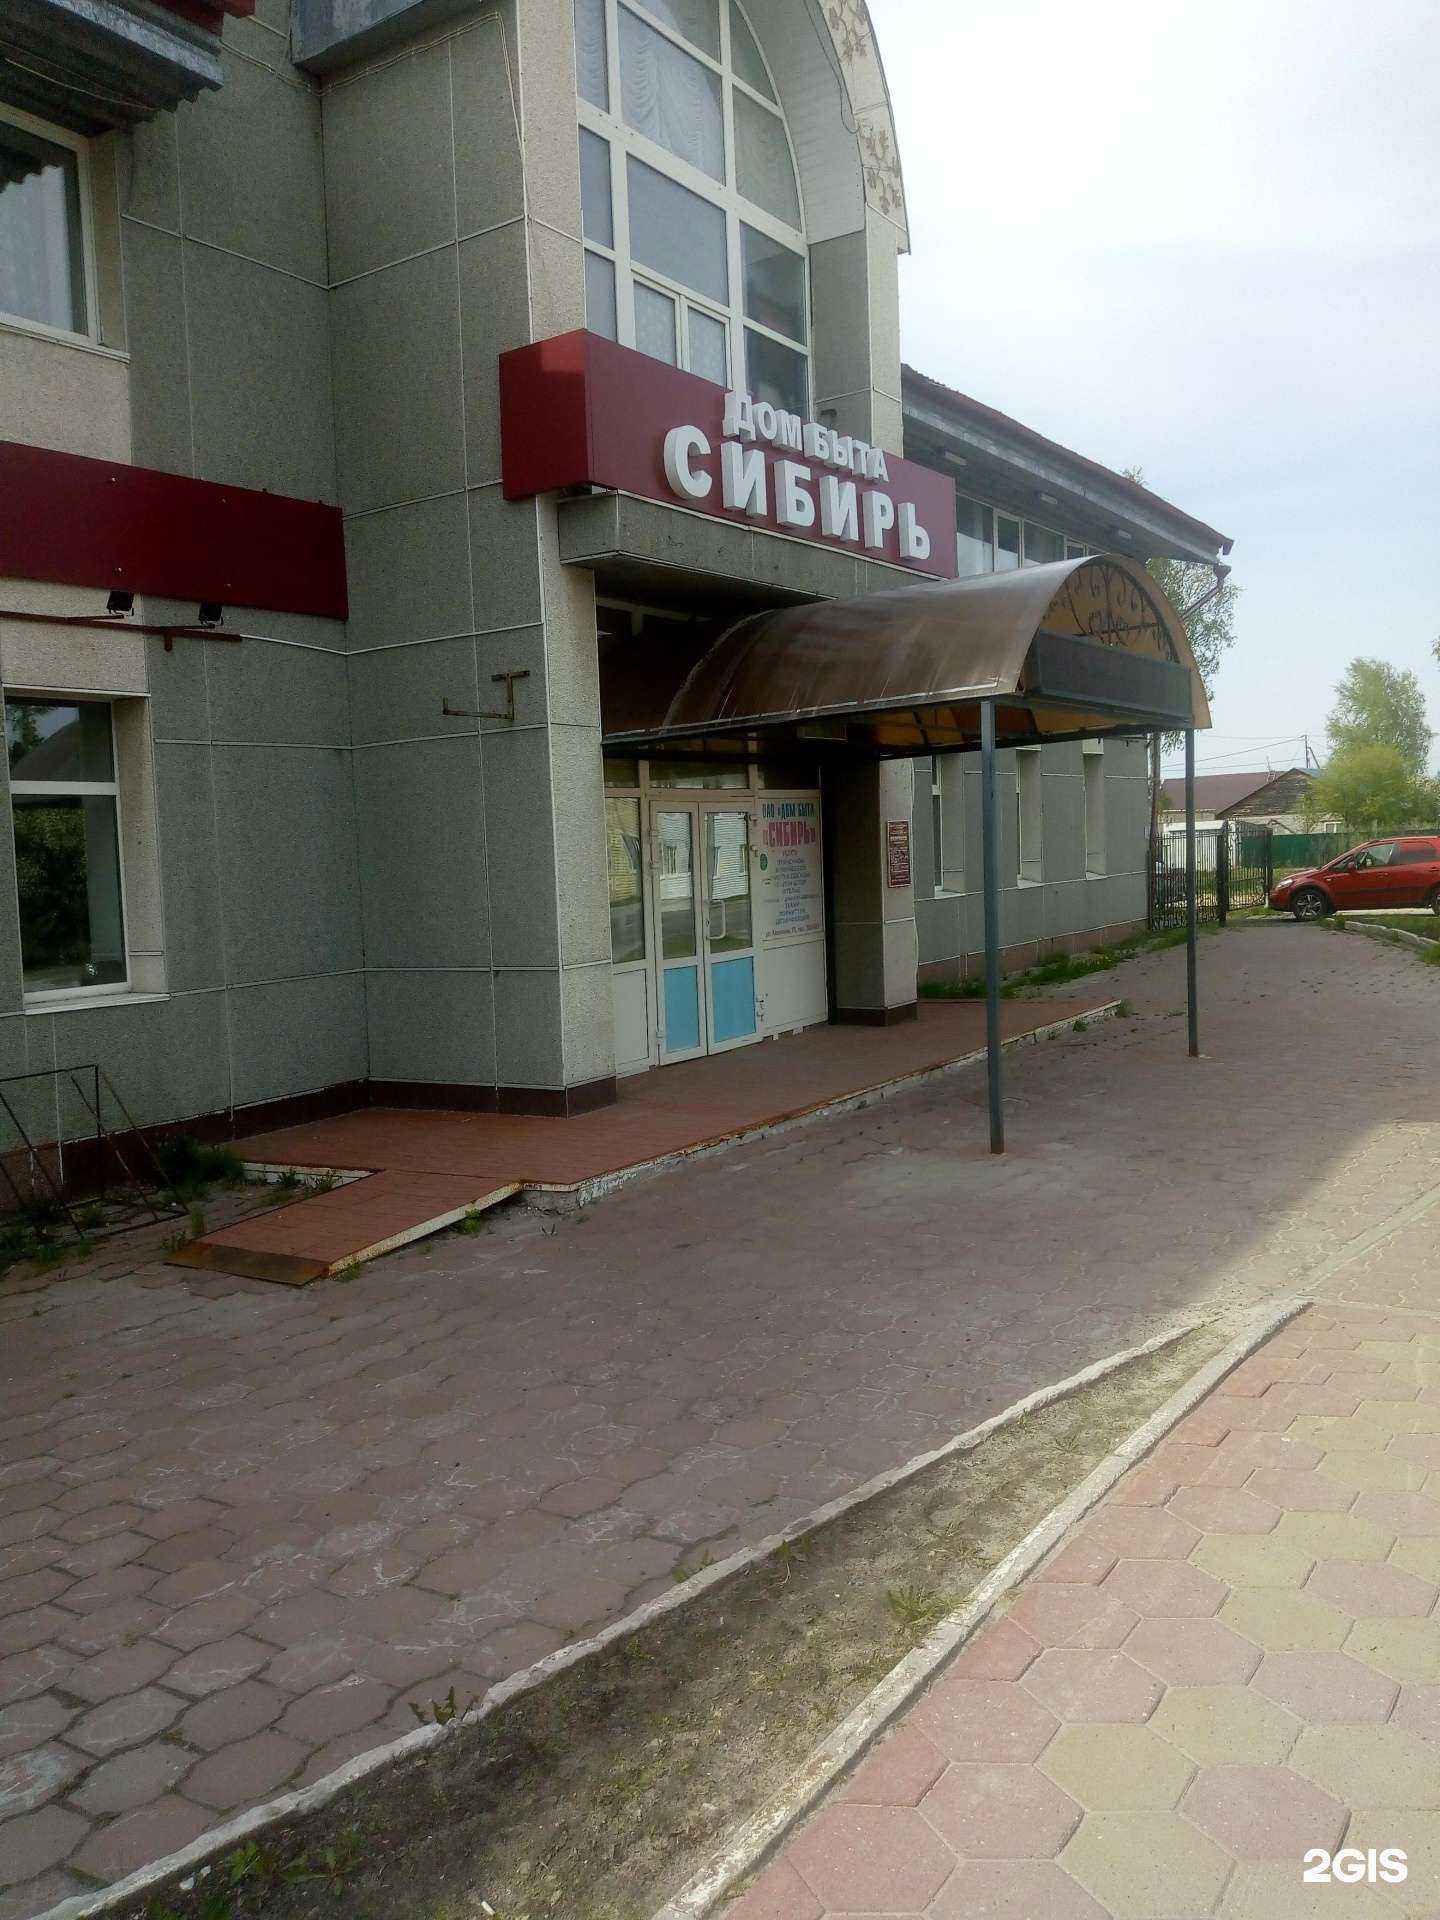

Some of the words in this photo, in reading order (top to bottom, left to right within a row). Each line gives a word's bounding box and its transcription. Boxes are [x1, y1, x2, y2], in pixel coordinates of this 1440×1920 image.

[663, 424, 931, 560] СИБИРЬ
[722, 390, 802, 451] ДОМ
[803, 422, 889, 483] БЫТА
